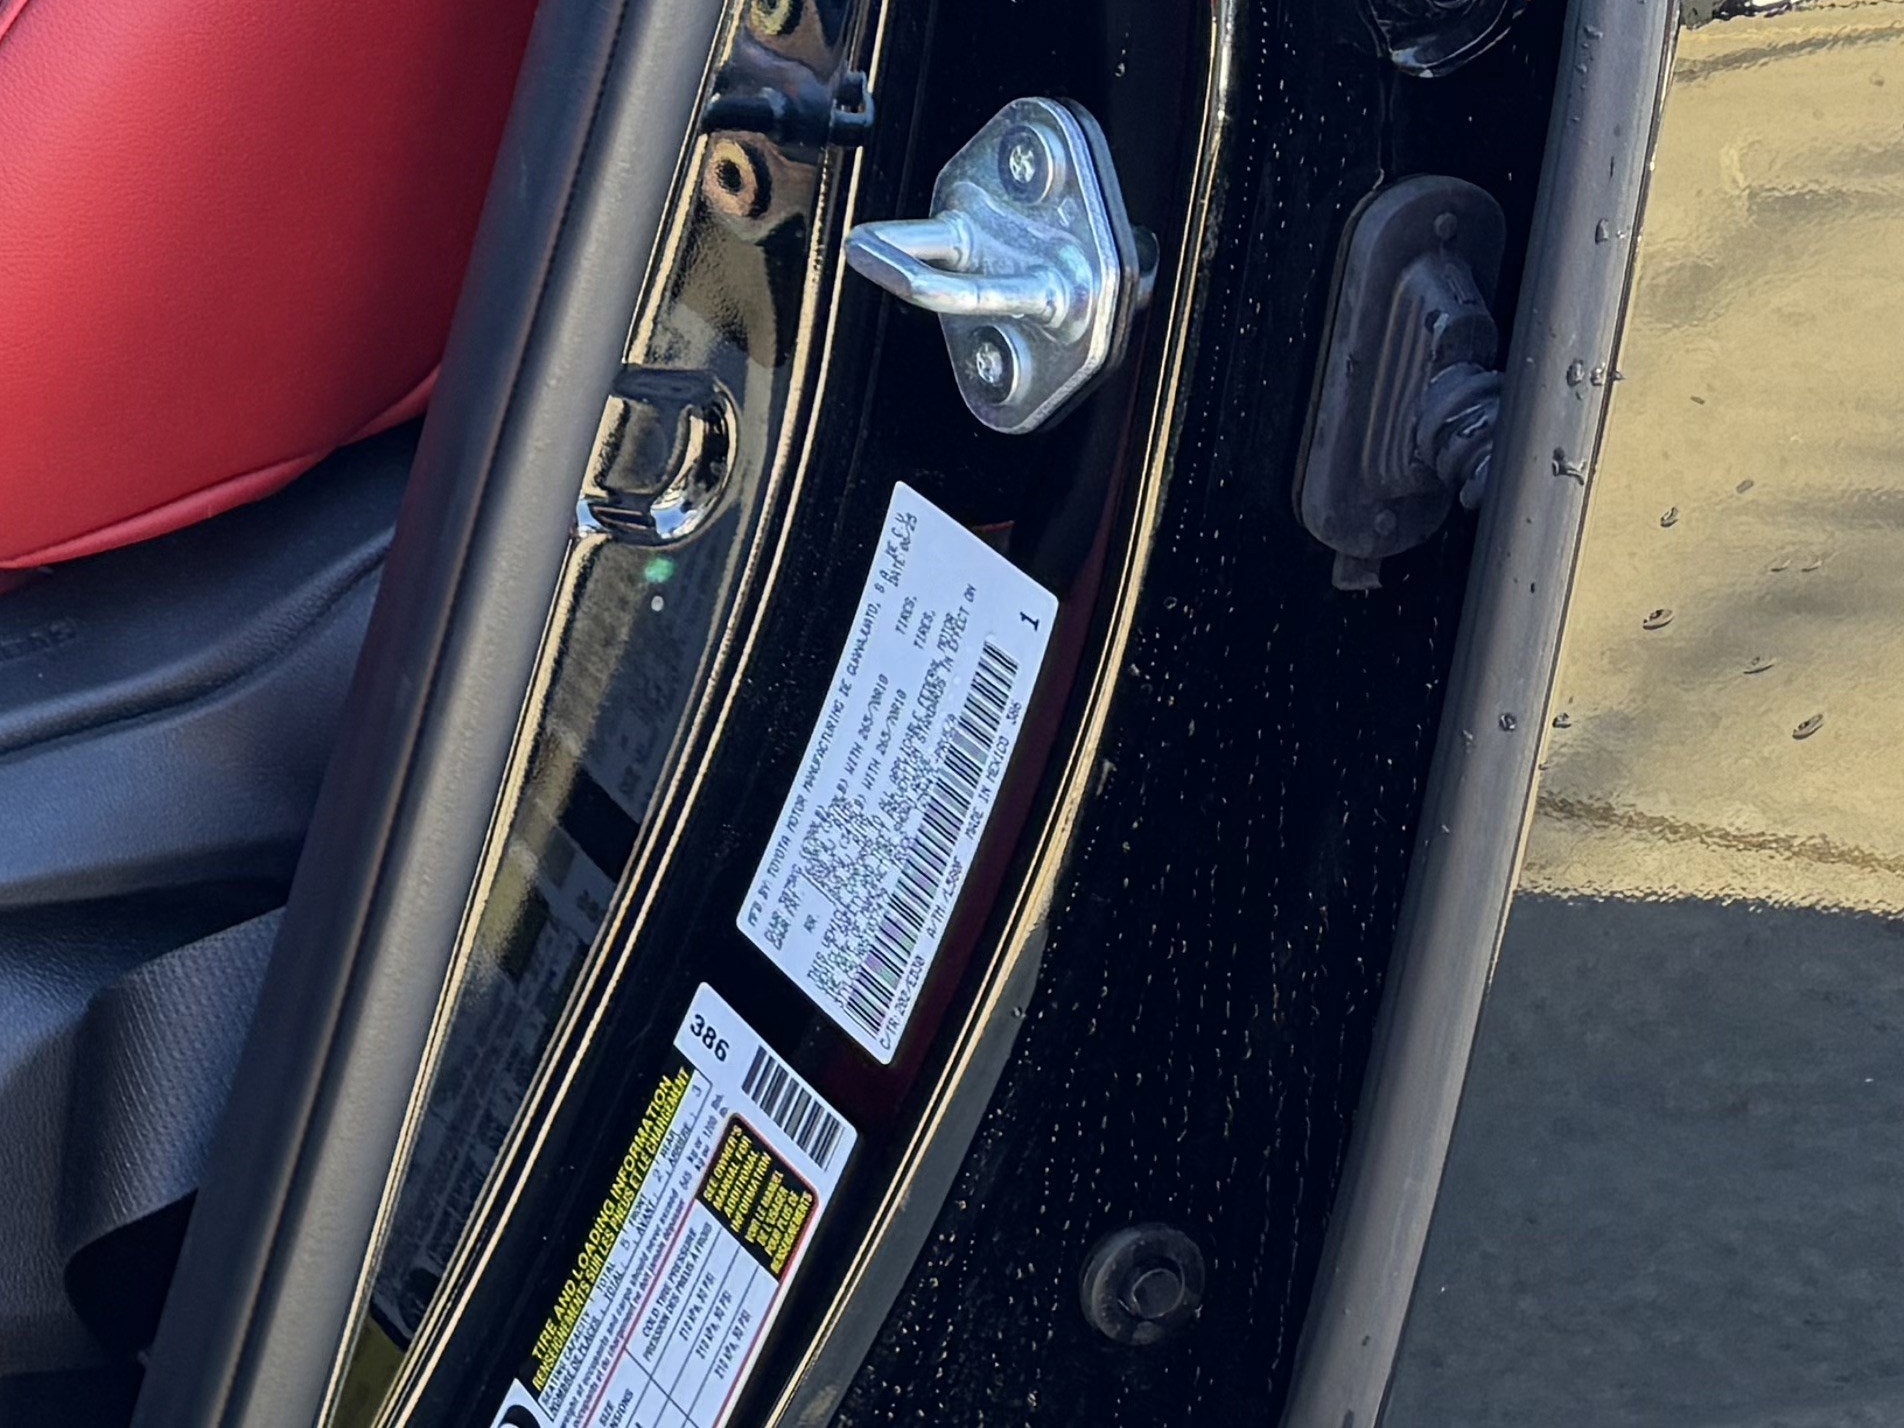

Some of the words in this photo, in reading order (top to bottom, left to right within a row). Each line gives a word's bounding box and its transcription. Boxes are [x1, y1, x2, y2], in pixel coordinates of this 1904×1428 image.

[1019, 608, 1041, 631] 1
[842, 738, 864, 777] WITH
[861, 755, 882, 792] WITH
[983, 731, 1010, 784] MEXICO
[976, 781, 992, 804] IN
[766, 831, 791, 880] TOYOTA
[785, 791, 807, 834] MOTOR
[689, 1013, 730, 1062] 386
[651, 1166, 663, 1183] 2
[722, 1147, 760, 1219] ADDITIONAL
[729, 1151, 773, 1234] INFORMATION
[531, 1316, 559, 1364] TIRE
[551, 1276, 578, 1322] AND
[570, 1196, 616, 1282] LOADING
[608, 1073, 673, 1201] INFORMATION
[583, 1251, 604, 1284] SUR
[596, 1226, 616, 1257] LES
[627, 1168, 643, 1190] ET
[635, 1149, 652, 1173] LE
[754, 1203, 767, 1222] LE
